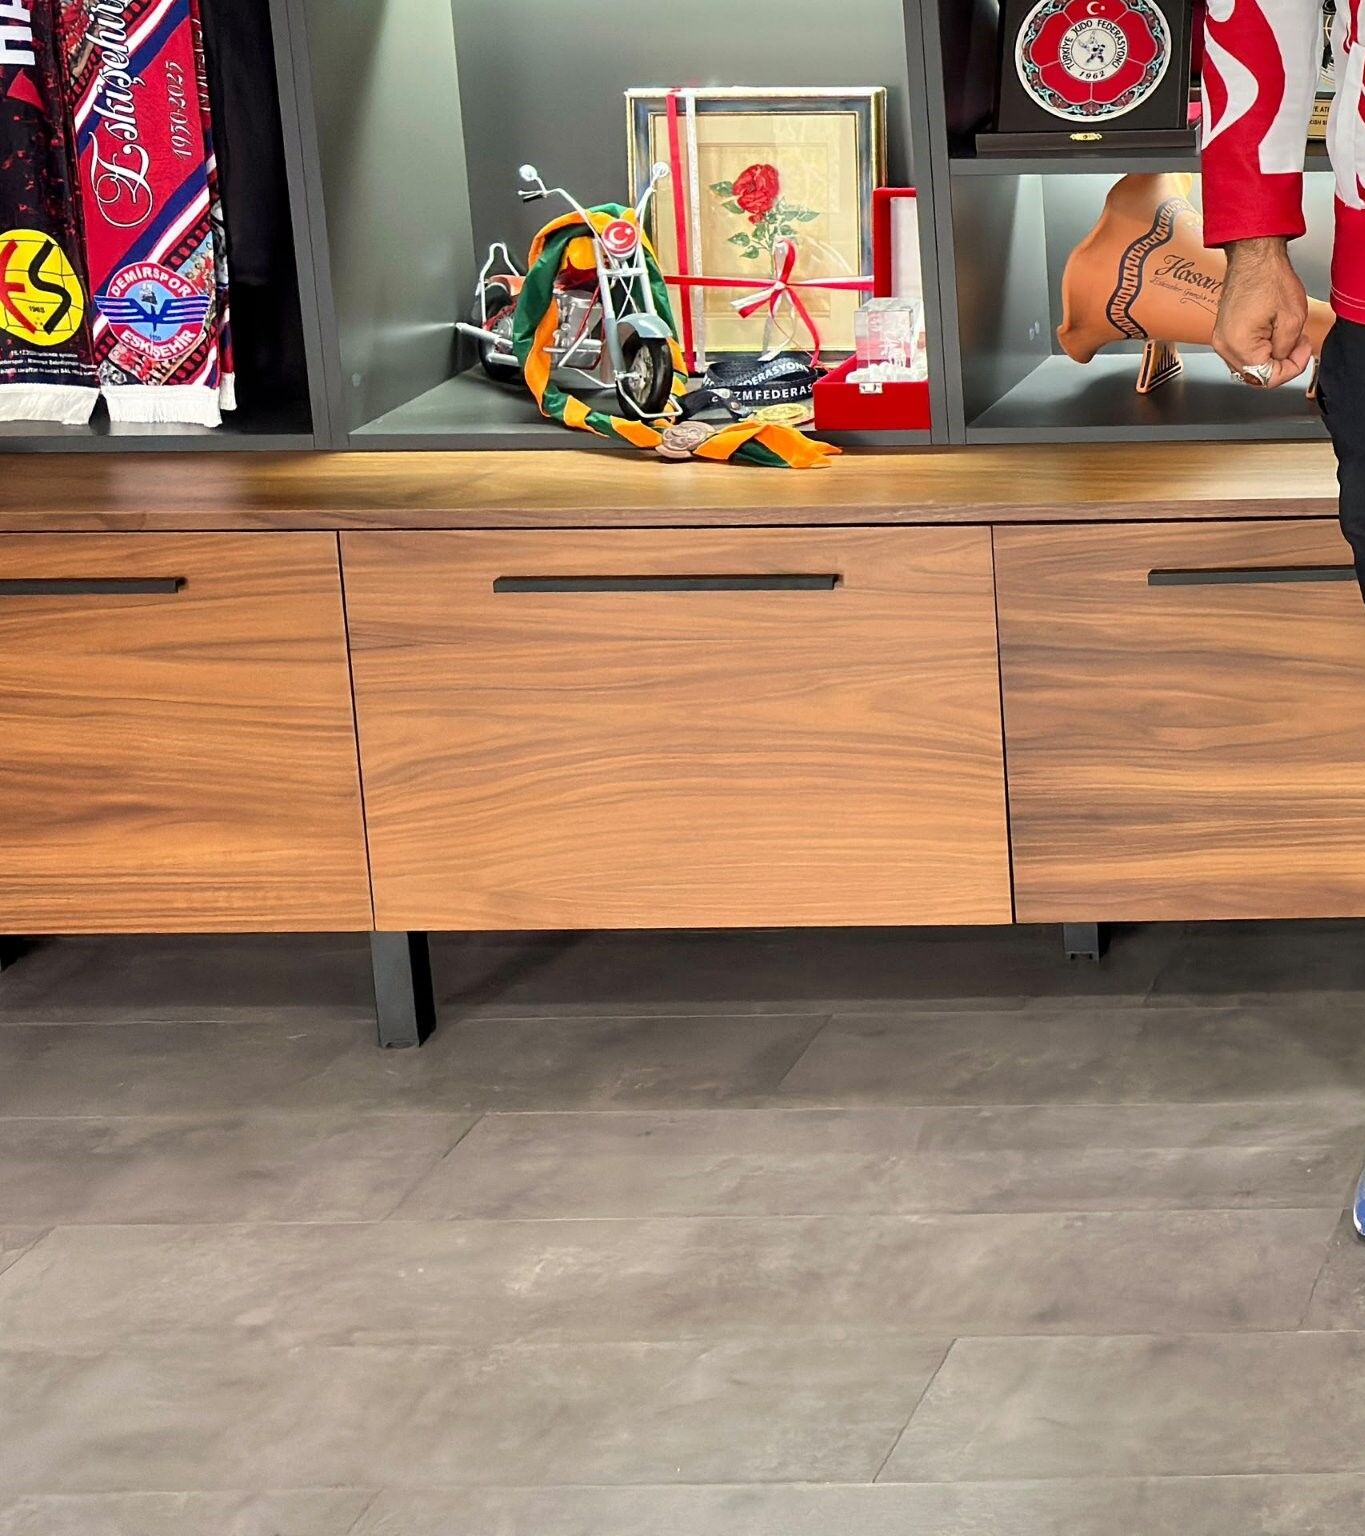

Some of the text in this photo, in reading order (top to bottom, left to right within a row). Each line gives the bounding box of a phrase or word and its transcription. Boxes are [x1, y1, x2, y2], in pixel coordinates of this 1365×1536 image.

[1071, 19, 1093, 37] JUDO
[1097, 19, 1126, 69] FEDERASYONU
[1079, 70, 1105, 79] 1962
[111, 266, 192, 297] DEMİRSPOR
[120, 329, 197, 359] ESKİŞEHİR
